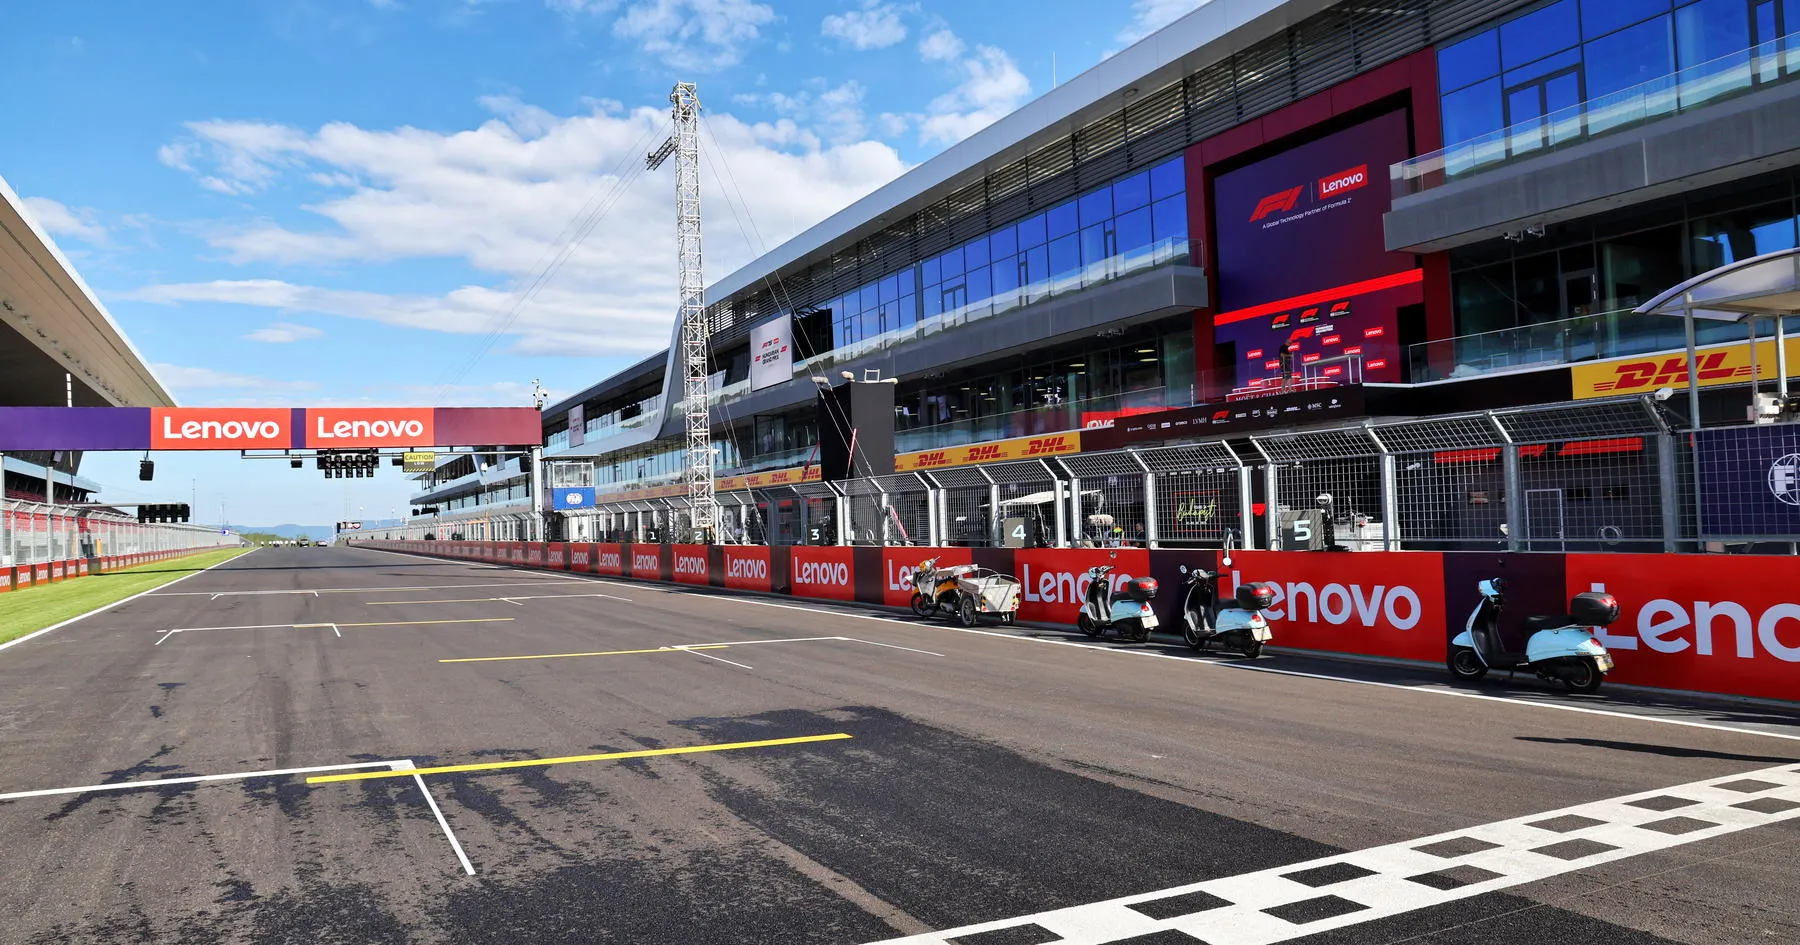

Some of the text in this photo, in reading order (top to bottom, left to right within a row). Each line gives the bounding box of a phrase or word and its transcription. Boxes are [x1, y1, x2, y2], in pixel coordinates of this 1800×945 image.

[1322, 173, 1363, 193] Lenovo
[1280, 212, 1304, 224] Technology
[1304, 208, 1321, 217] Partner
[1328, 200, 1347, 209] Formula
[1614, 352, 1736, 390] DHL
[164, 416, 280, 439] Lenovo
[318, 416, 424, 438] Lenovo
[968, 445, 1000, 461] DHL
[1029, 437, 1067, 454] DHL
[918, 452, 946, 467] DHL
[1177, 498, 1216, 522] Budapest
[650, 532, 656, 540] 1
[695, 531, 702, 540] 2
[811, 529, 820, 540] 3
[1012, 525, 1026, 540] 4
[1294, 520, 1311, 541] 5
[571, 548, 588, 564] Lenovo
[599, 549, 620, 567] Lenovo
[633, 552, 657, 570] Lenovo
[674, 552, 706, 574] Lenovo
[727, 554, 766, 579] Lenovo
[794, 557, 848, 585] Lenovo
